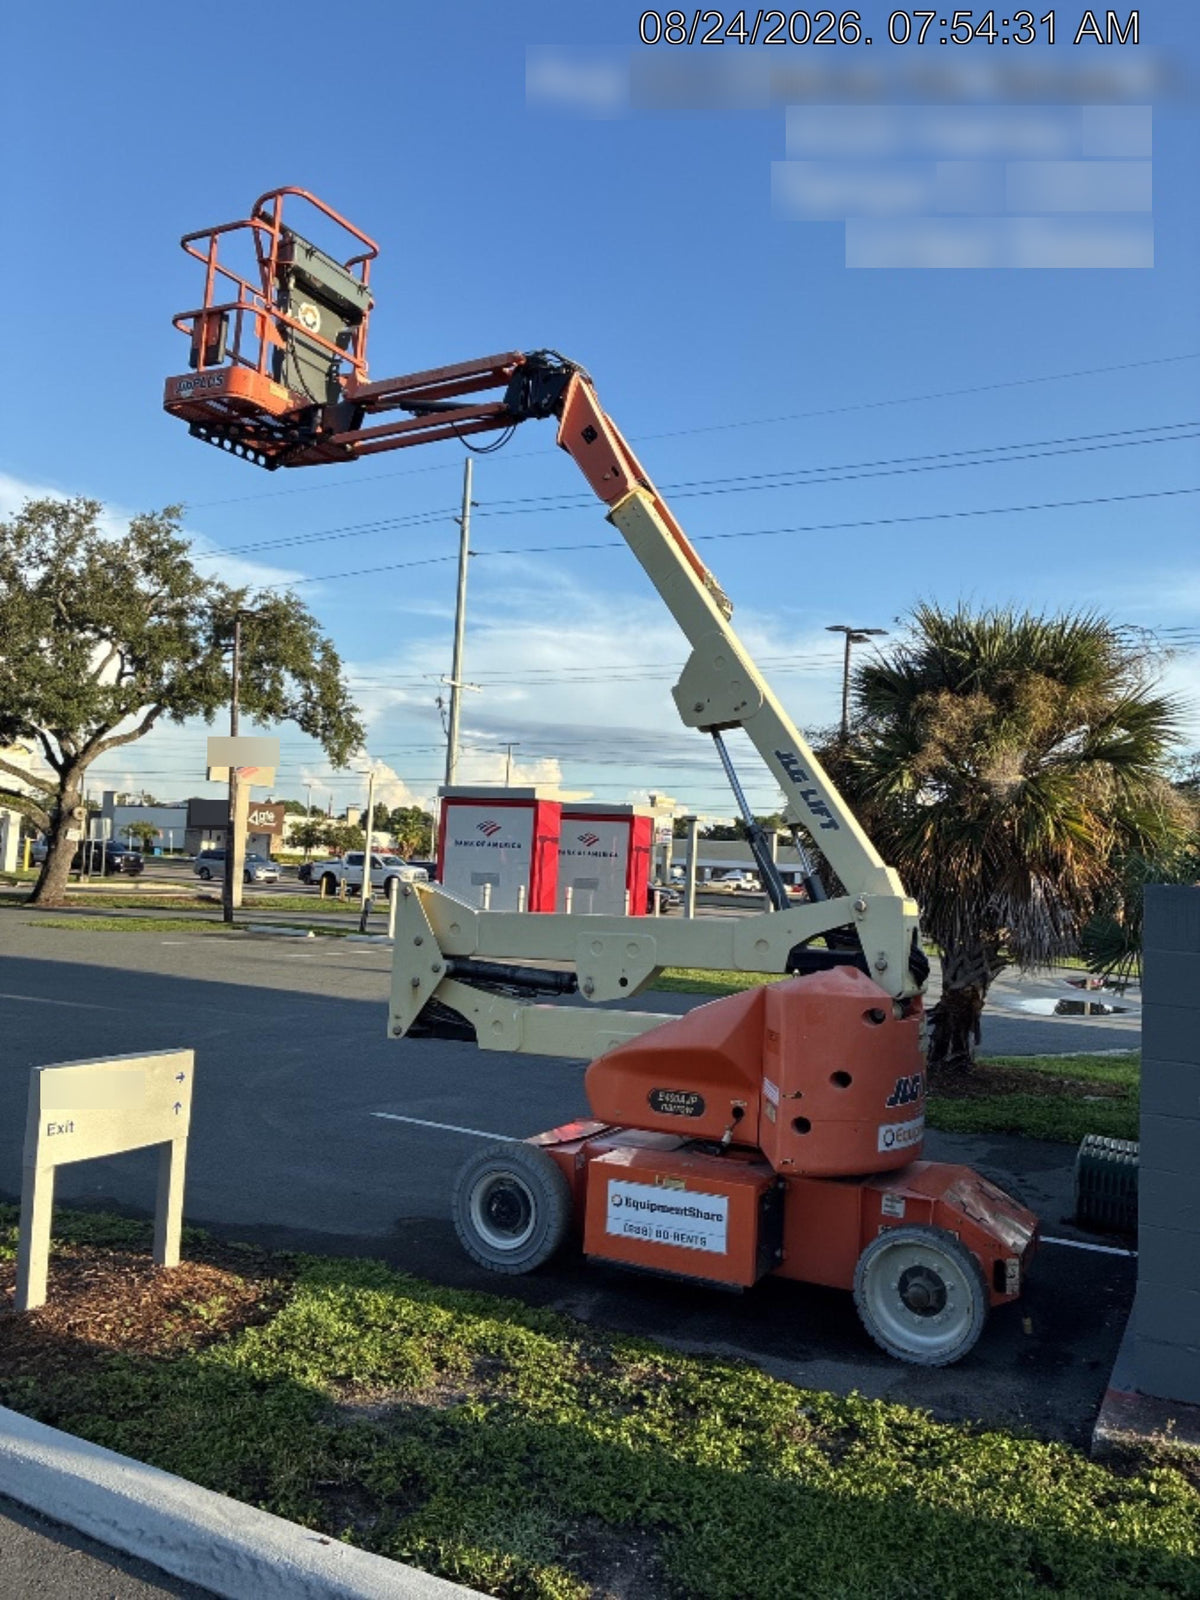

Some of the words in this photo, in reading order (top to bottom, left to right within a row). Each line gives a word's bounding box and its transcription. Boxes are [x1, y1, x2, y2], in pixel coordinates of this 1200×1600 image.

[775, 750, 809, 783] JLG
[800, 789, 839, 830] LIFT
[487, 840, 522, 849] AMERICA
[885, 1072, 922, 1108] JLG
[46, 1120, 75, 1137] Exit
[624, 1196, 724, 1222] EquipmentShare
